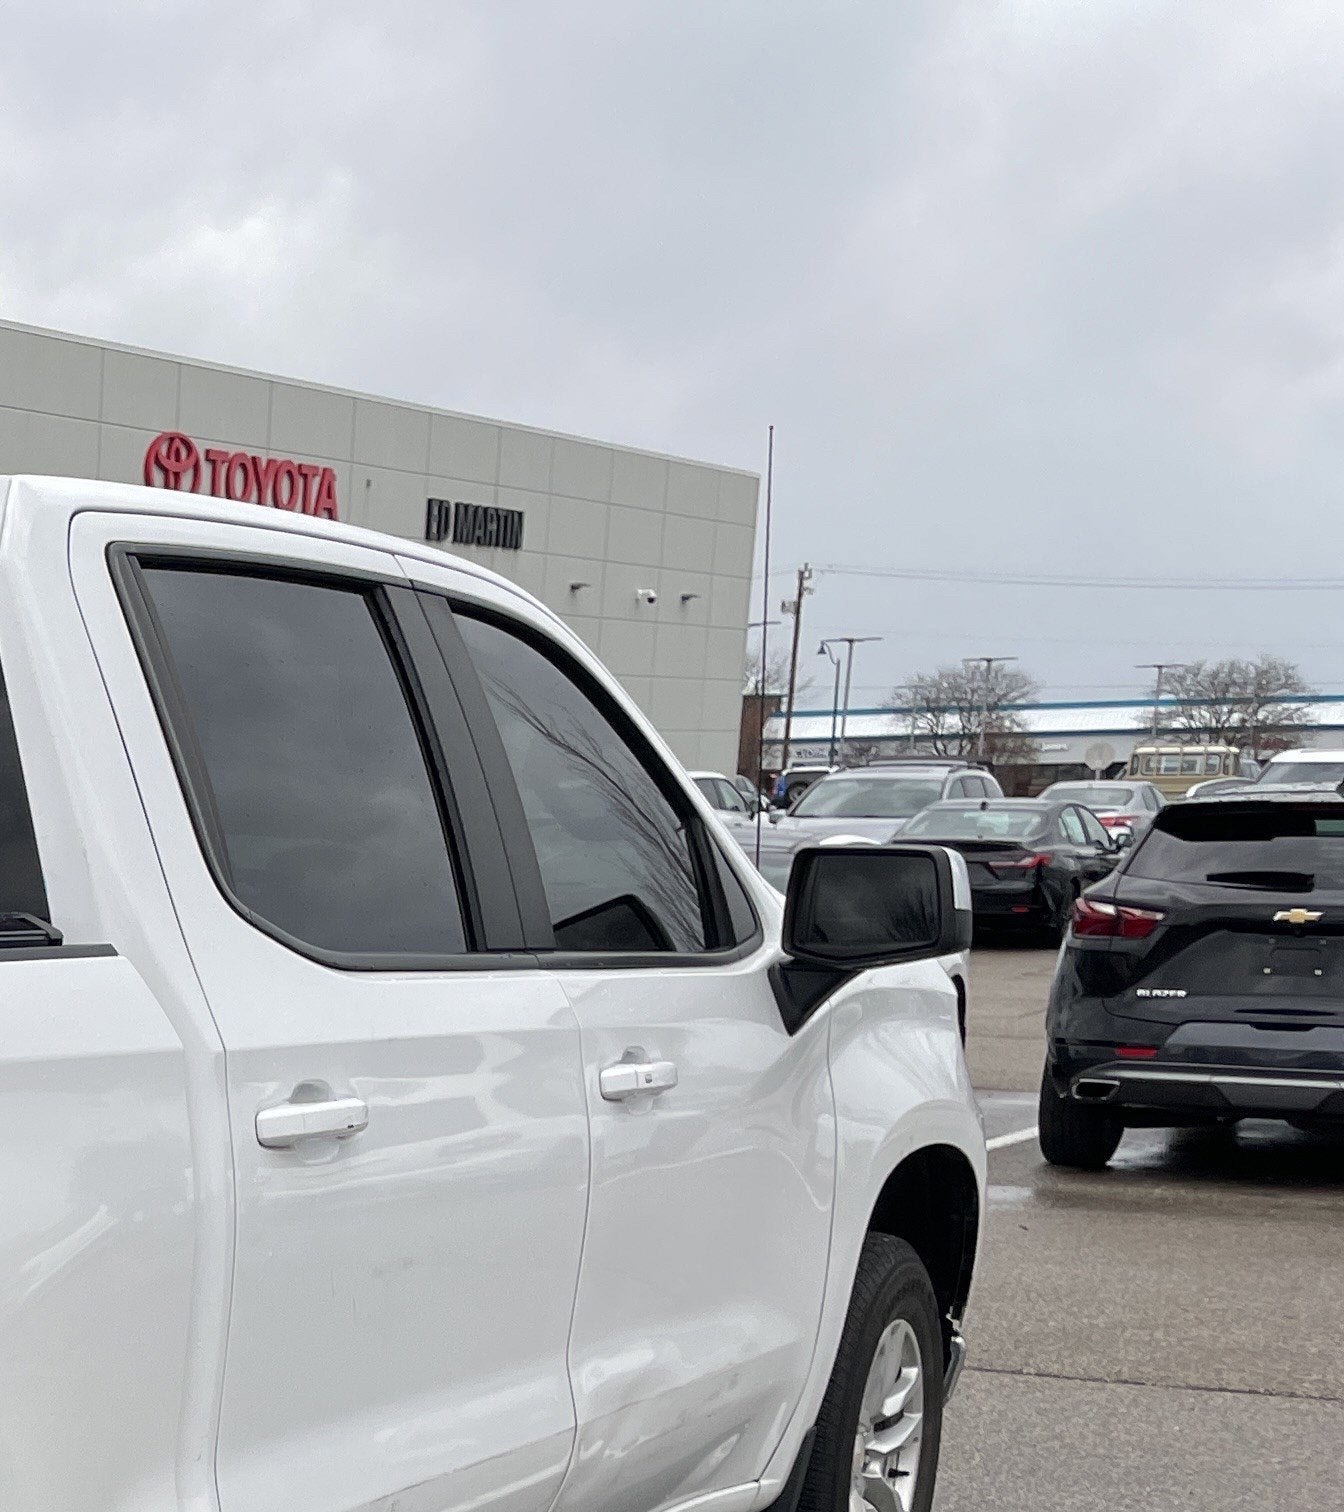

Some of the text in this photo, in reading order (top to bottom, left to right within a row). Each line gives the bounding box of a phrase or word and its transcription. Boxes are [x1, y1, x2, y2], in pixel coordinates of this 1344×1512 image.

[205, 448, 340, 521] TOYOTA
[425, 498, 524, 549] ED MARTIN
